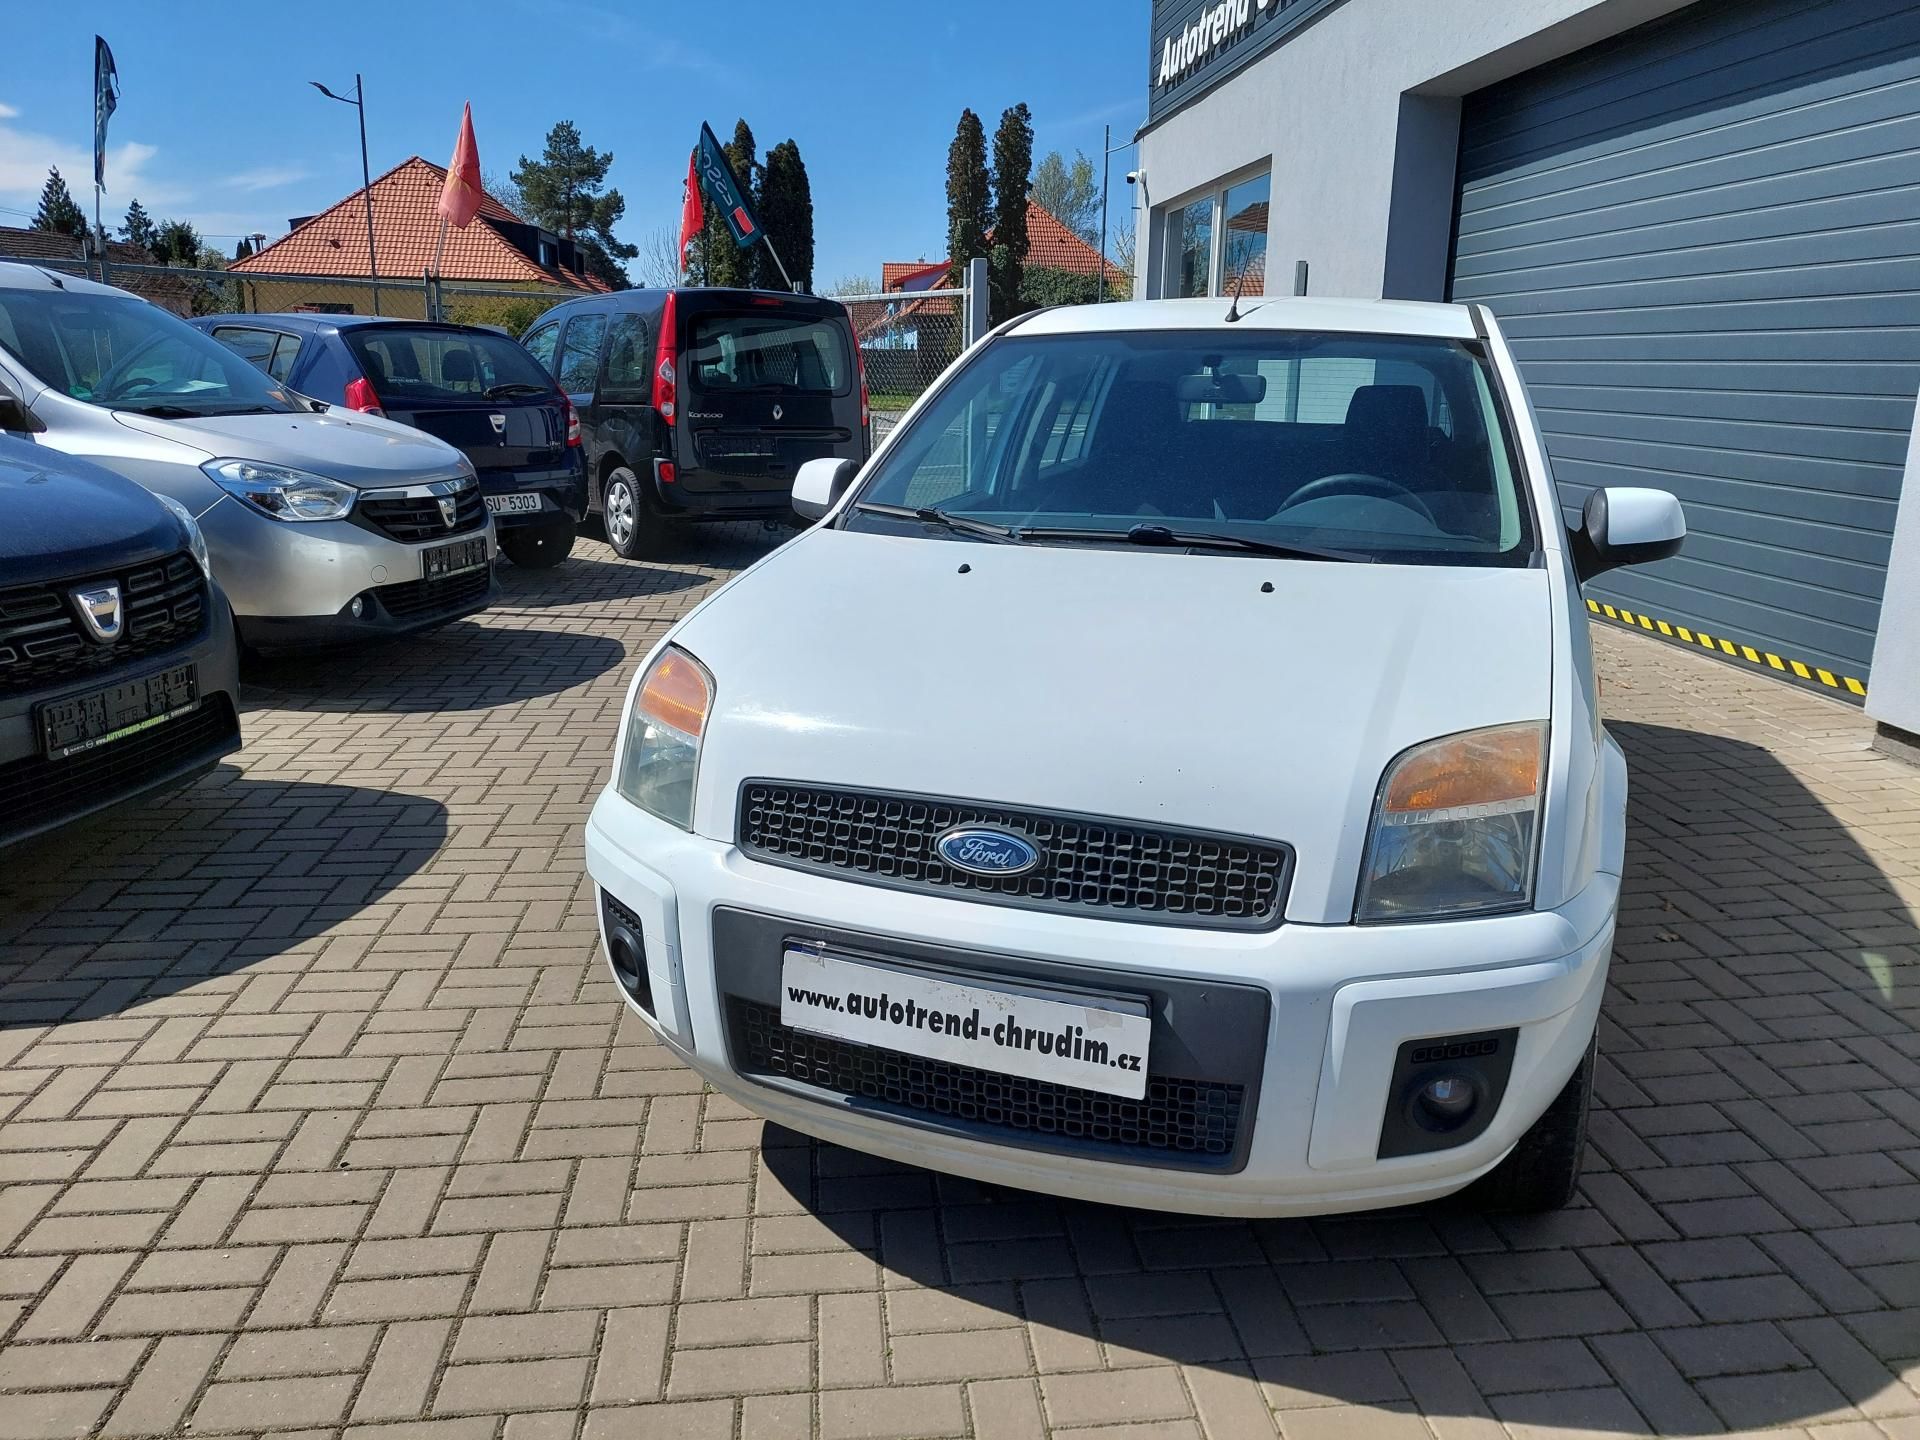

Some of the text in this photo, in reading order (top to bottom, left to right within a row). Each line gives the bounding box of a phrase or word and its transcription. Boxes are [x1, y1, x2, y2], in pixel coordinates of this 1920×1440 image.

[508, 495, 537, 510] 5303
[959, 838, 1012, 865] Ford
[787, 985, 1142, 1073] www.autotrend-chrudim.cz
